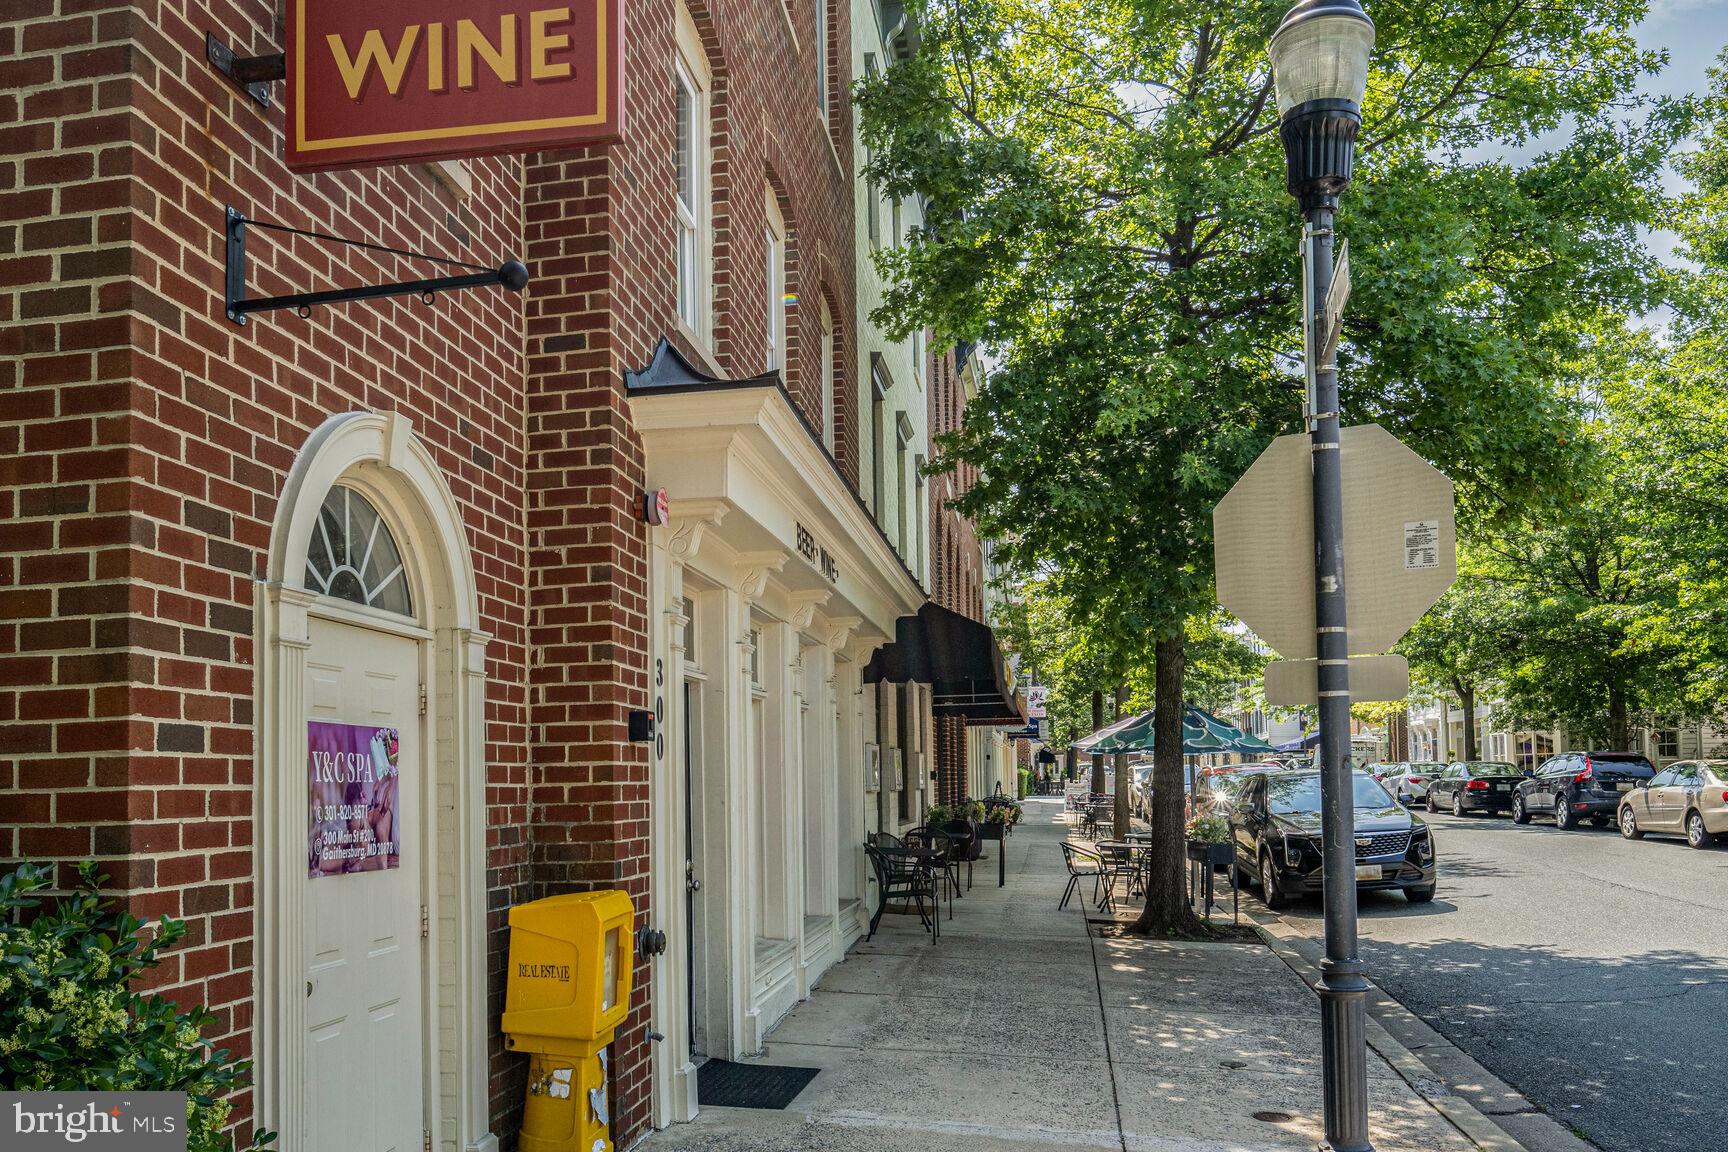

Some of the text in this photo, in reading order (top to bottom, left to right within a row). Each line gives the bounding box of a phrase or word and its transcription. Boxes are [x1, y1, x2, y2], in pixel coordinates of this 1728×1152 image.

[326, 8, 573, 99] WINE
[796, 521, 815, 564] BEER
[656, 658, 664, 761] 300
[312, 751, 374, 783] Y&C SPA
[322, 845, 366, 860] Gaithersburg,
[367, 843, 377, 856] MD
[323, 831, 337, 845] 300
[337, 830, 353, 844] Main
[353, 829, 359, 843] St
[519, 964, 569, 979] REAL ESTATE
